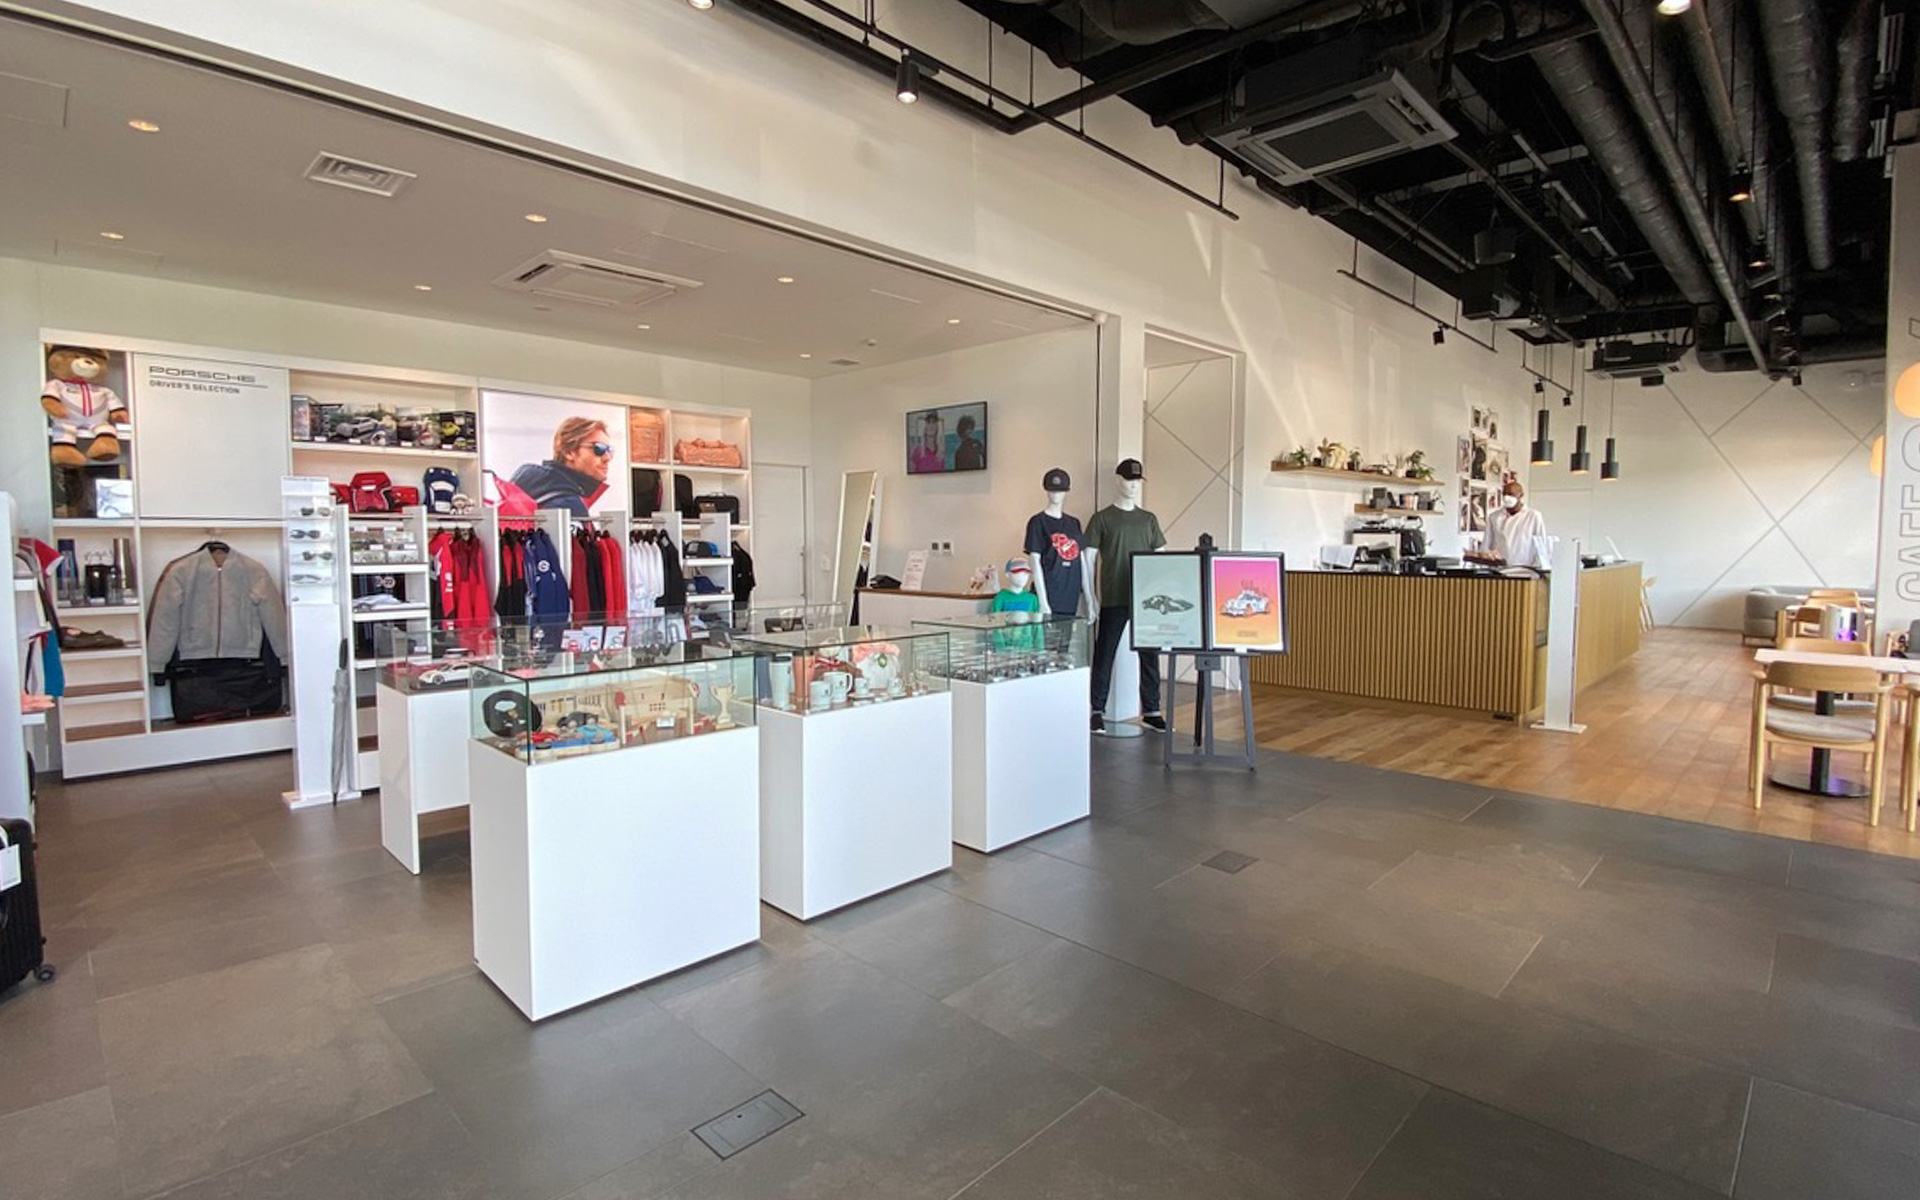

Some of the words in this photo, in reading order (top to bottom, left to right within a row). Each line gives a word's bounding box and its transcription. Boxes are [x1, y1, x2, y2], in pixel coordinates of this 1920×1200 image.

[149, 366, 256, 383] PORSCHE
[149, 379, 191, 391] DRIVER'S
[192, 383, 240, 394] SELECTION
